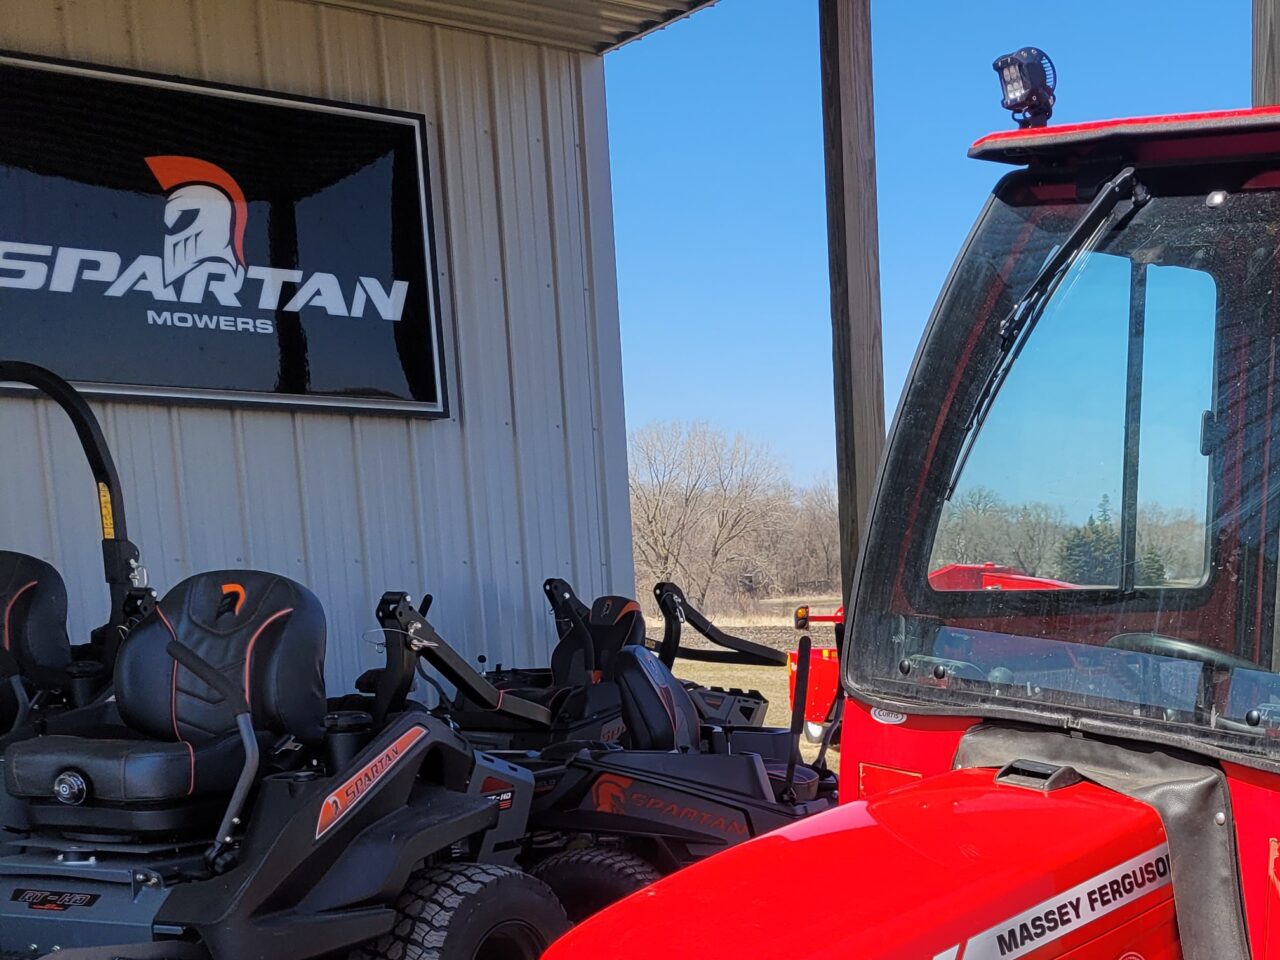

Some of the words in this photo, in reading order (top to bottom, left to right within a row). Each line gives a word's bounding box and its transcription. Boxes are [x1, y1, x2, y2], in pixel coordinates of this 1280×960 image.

[0, 241, 410, 321] SPARTAN
[147, 310, 274, 334] MOWERS
[878, 710, 899, 720] CURTIS
[344, 746, 401, 804] SPARTAN
[630, 792, 748, 836] SPARTAN
[996, 897, 1081, 956] MASSEY
